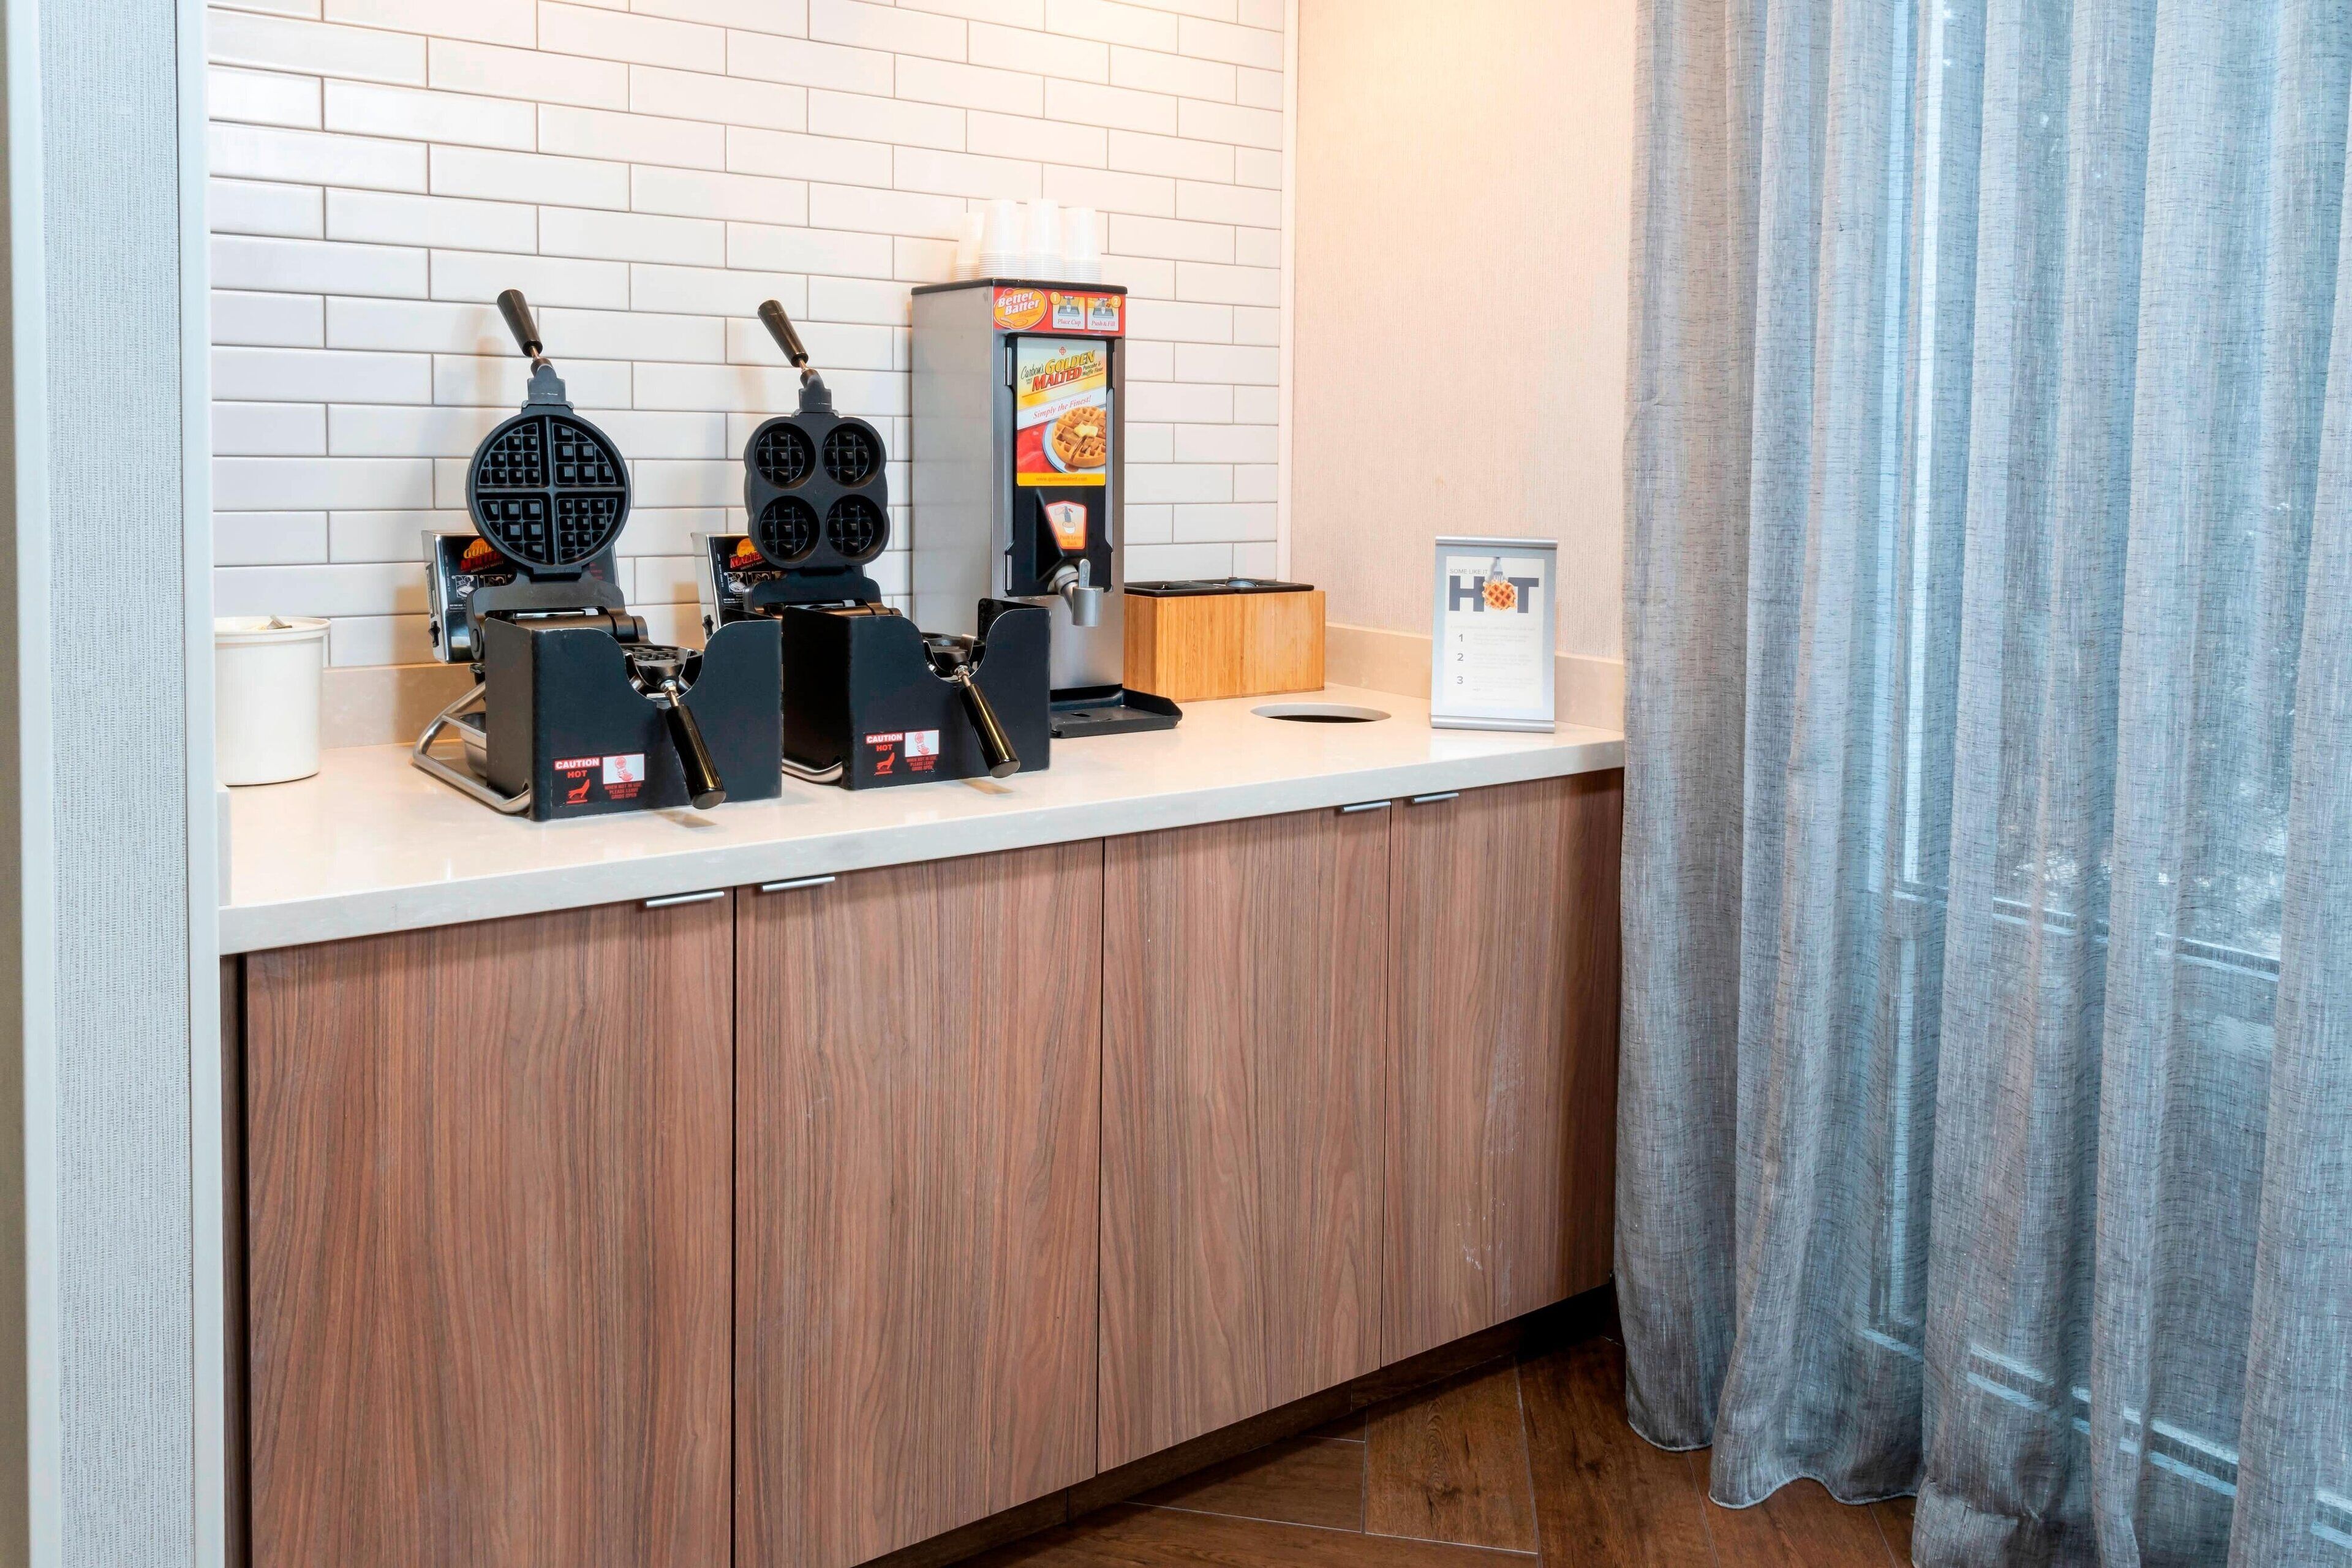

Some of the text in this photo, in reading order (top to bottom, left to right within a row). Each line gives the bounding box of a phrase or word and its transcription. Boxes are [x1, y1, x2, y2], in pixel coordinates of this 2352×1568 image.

[997, 291, 1034, 308] Better
[1005, 299, 1041, 315] Batter
[1044, 350, 1096, 374] GOLDEN
[1032, 366, 1083, 392] MALTED
[1033, 395, 1091, 419] Simply the Finest!
[1458, 633, 1463, 642] 1
[1457, 676, 1463, 684] 3
[866, 734, 903, 743] CAUTION
[556, 758, 599, 769] CAUTION
[567, 770, 587, 778] HOT
